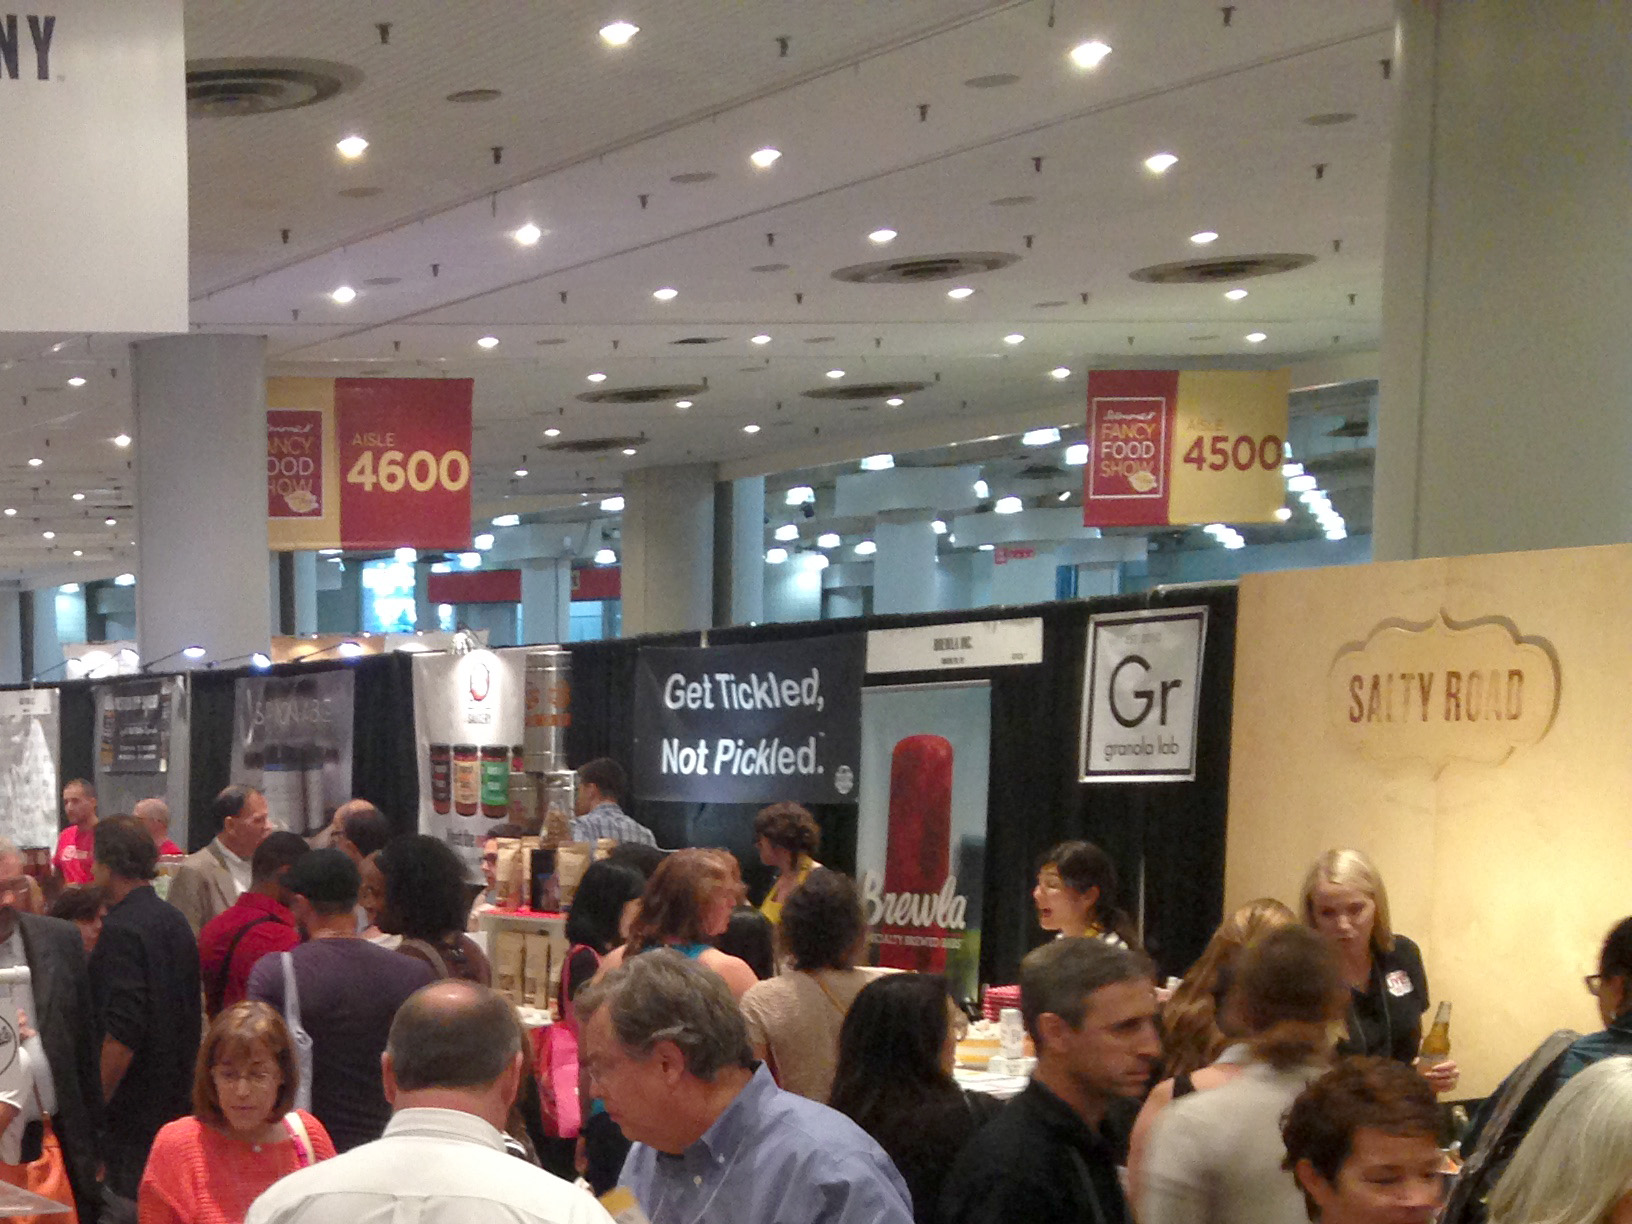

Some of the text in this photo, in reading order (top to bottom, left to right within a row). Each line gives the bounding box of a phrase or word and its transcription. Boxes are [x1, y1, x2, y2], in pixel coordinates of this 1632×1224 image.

[353, 432, 395, 447] AISLE
[1102, 423, 1158, 439] FANCY
[268, 457, 314, 475] OOD
[1101, 442, 1155, 458] FOOD
[1183, 435, 1283, 471] 4500
[347, 450, 470, 492] 4600
[1102, 461, 1155, 477] SHOW
[665, 667, 824, 712] Get Tickled,
[1109, 655, 1182, 728] Gr
[1349, 668, 1524, 723] SALTY ROAD
[661, 736, 824, 775] Not Pickled.
[1104, 735, 1179, 761] granola lab
[864, 872, 967, 929] Brewla
